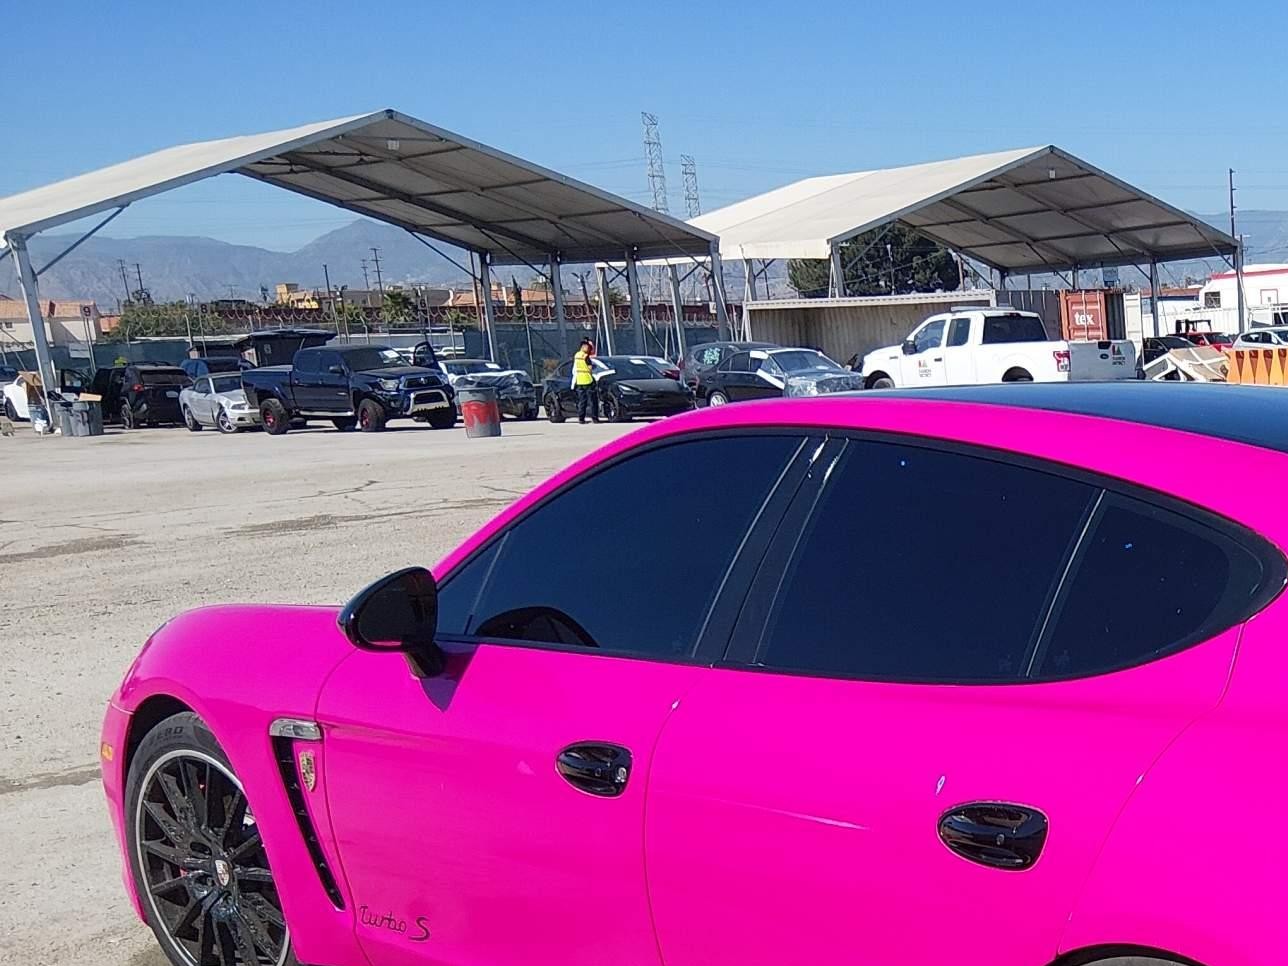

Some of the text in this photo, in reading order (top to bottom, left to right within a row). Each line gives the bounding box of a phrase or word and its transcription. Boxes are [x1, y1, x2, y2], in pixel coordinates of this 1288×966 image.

[83, 306, 91, 317] 9
[200, 303, 208, 314] 8
[1074, 311, 1095, 326] tex
[359, 905, 431, 942] Turbo S
